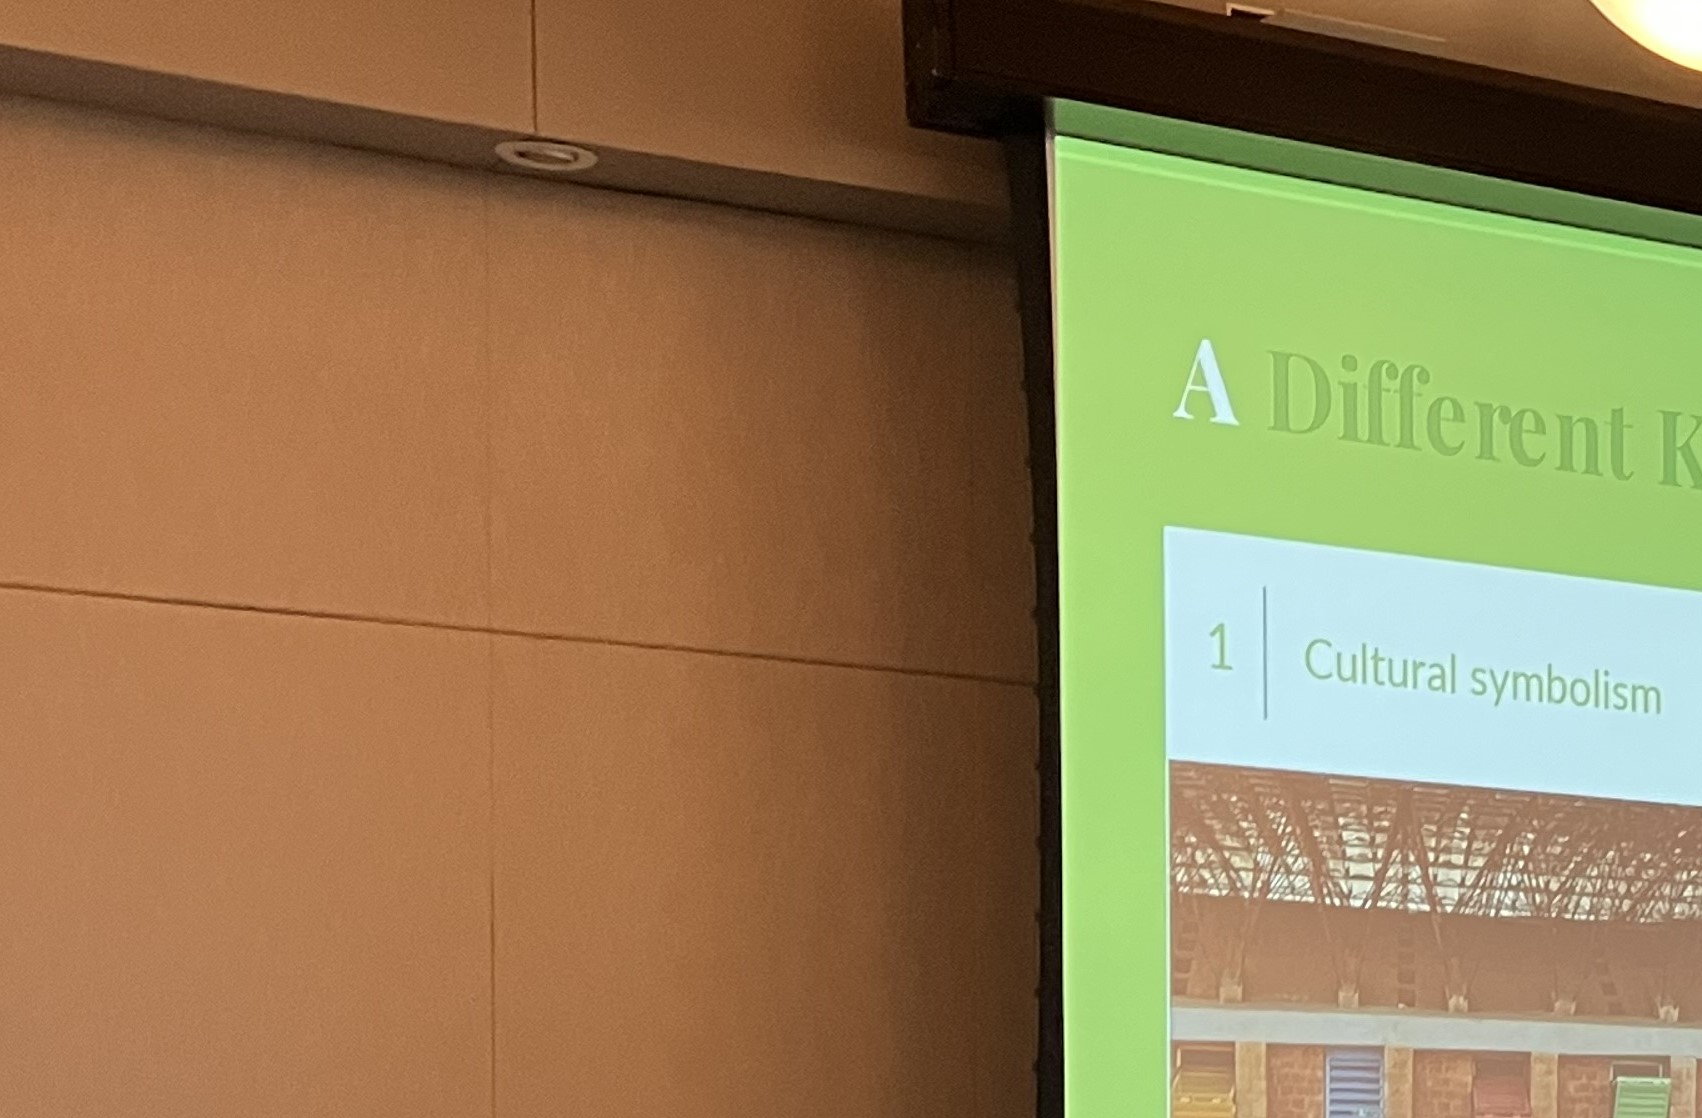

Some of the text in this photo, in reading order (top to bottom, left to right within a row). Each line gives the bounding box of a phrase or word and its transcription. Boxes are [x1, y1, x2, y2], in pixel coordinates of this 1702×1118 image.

[1173, 338, 1239, 426] A
[1266, 348, 1635, 482] Different
[1208, 622, 1234, 671] 1
[1304, 637, 1662, 716] Cultural symbolism
